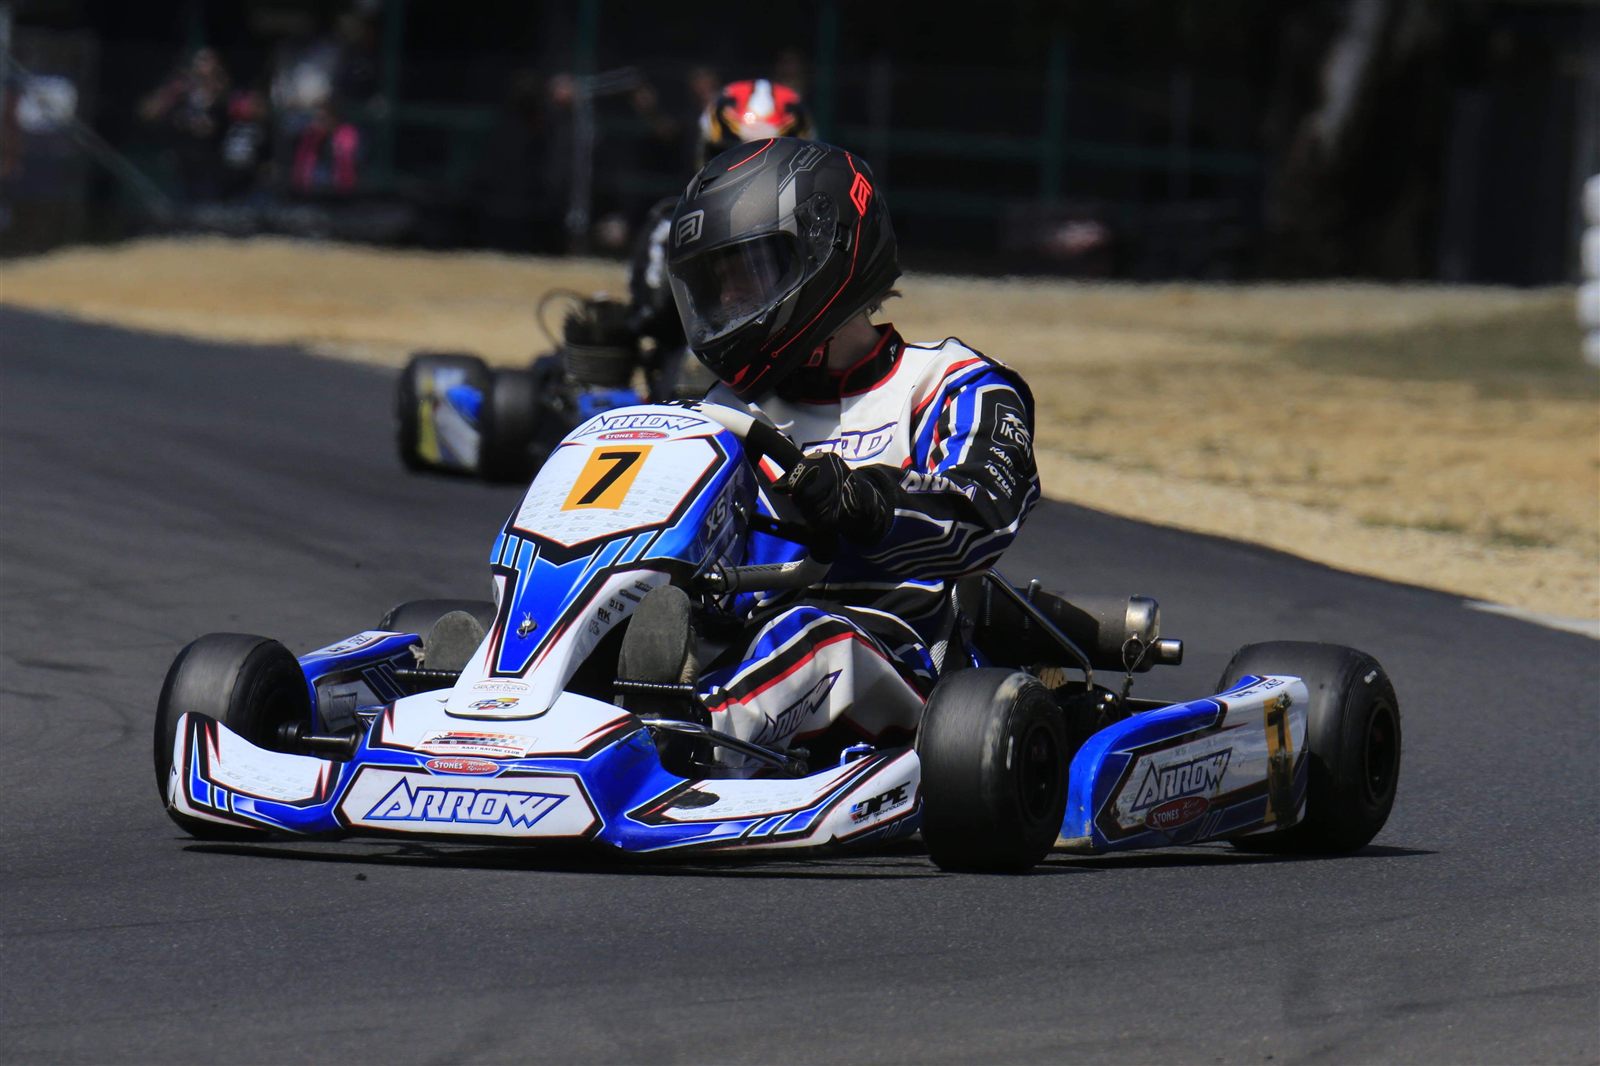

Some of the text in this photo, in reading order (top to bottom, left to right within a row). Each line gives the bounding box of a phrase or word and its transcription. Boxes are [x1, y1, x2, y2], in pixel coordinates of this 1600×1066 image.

[571, 414, 710, 441] ARROW
[576, 452, 641, 505] 7
[433, 760, 463, 769] STONES
[1130, 746, 1233, 813] ARROW
[362, 776, 570, 829] ARROW
